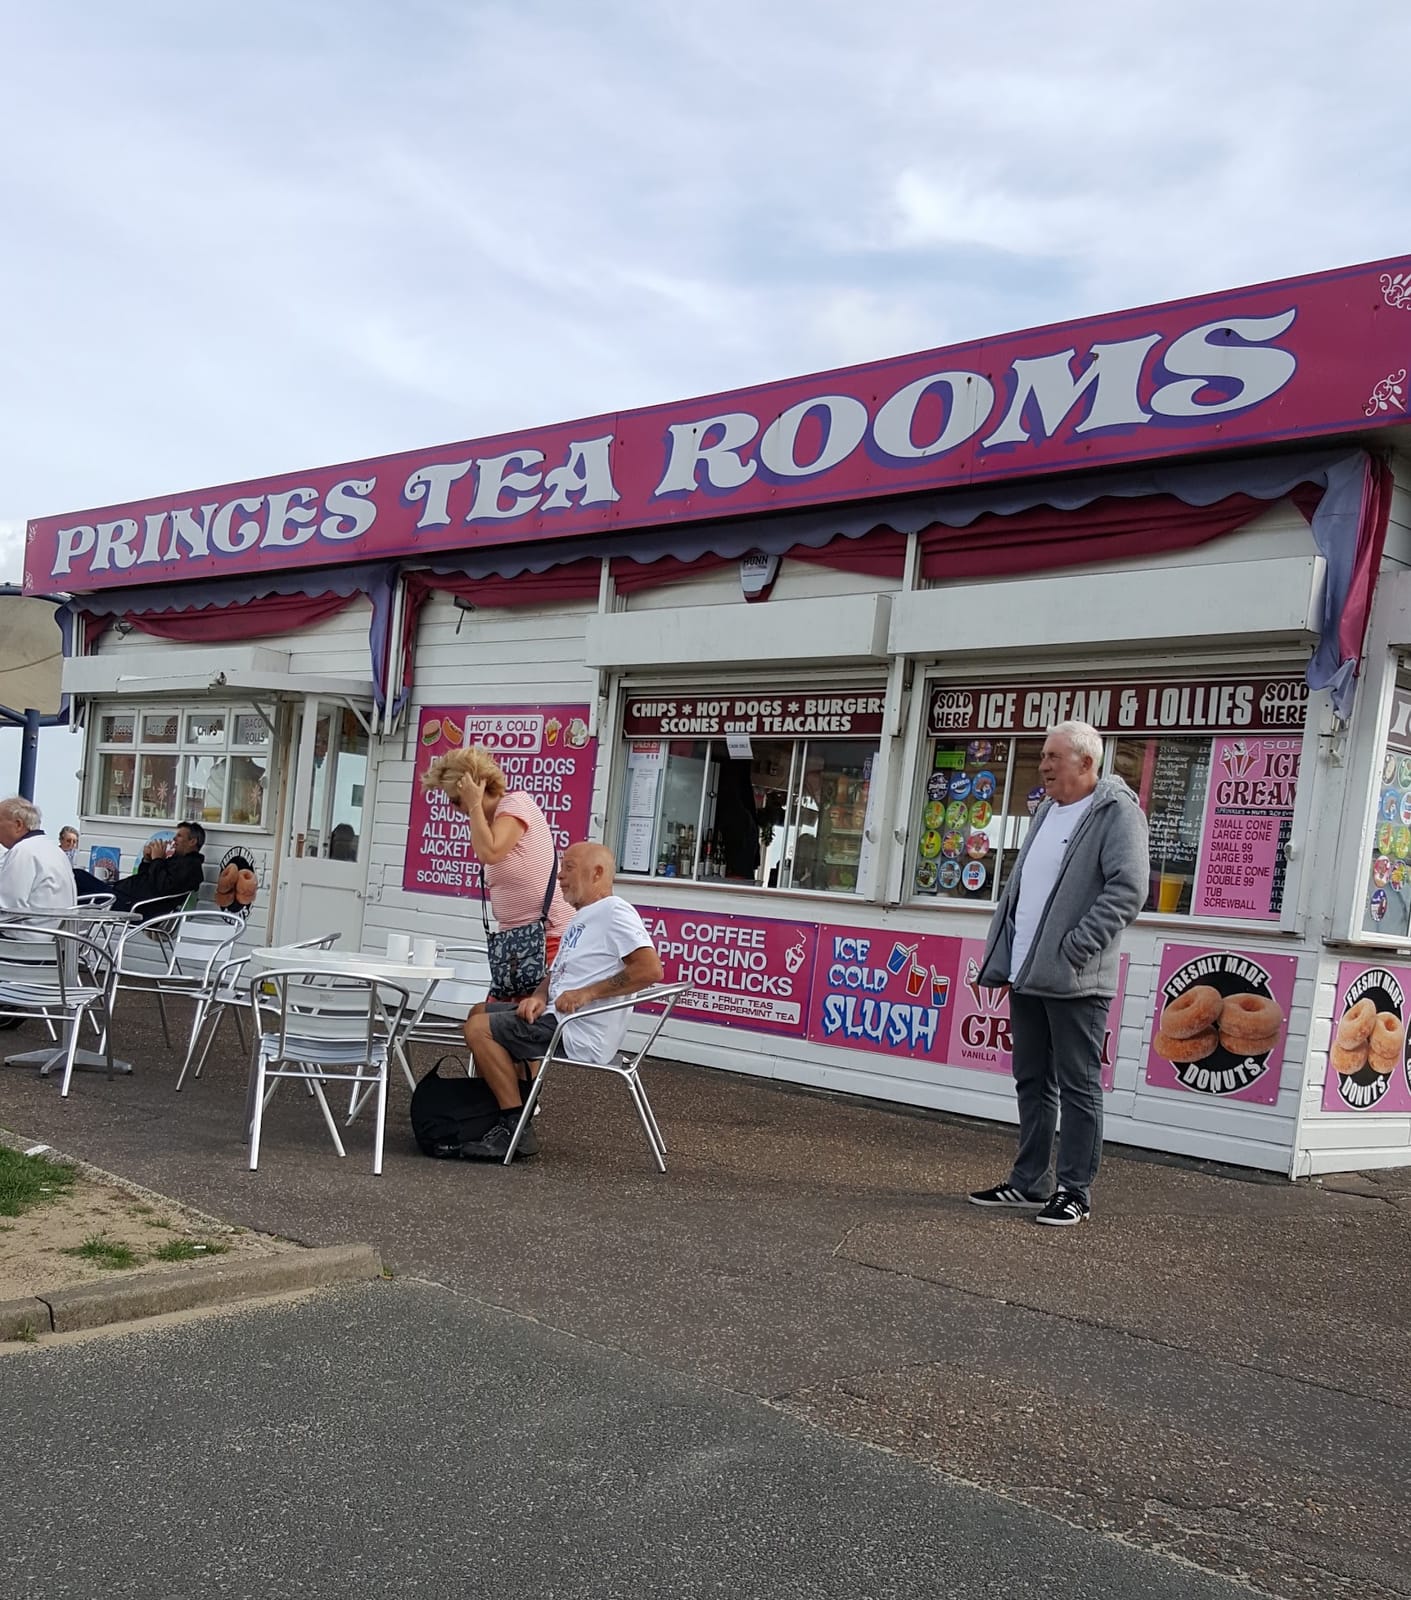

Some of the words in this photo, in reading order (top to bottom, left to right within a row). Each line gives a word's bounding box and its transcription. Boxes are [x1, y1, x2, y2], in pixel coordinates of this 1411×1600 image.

[50, 476, 378, 576] PRINCES
[404, 433, 620, 528] TEA
[653, 308, 1297, 495] ROOMS
[1265, 683, 1309, 701] SOLD
[632, 702, 677, 717] CHIPS
[696, 701, 730, 716] HOT
[734, 700, 783, 715] DOGS
[938, 694, 970, 709] SOLD
[977, 694, 1016, 728] ICE
[1023, 690, 1112, 728] CREAM
[1118, 691, 1138, 726] &
[1145, 686, 1254, 726] LOLLIES
[936, 712, 969, 727] HERE
[1263, 705, 1308, 723] HERE
[198, 725, 218, 736] CHIPS
[471, 720, 493, 731] HOT
[496, 720, 503, 731] &
[507, 720, 538, 731] COLD
[660, 718, 719, 732] SCONES
[724, 717, 757, 732] and
[763, 716, 852, 732] TEACAKES
[245, 732, 265, 742] ROLLS
[470, 732, 536, 748] FOOD
[1263, 740, 1302, 750] SOF
[501, 757, 527, 775] HOT
[532, 758, 576, 776] DOGS
[505, 775, 562, 793] URGERS
[430, 805, 470, 823] SAUS
[422, 822, 446, 839] ALL
[1213, 819, 1243, 829] SMALL
[1246, 820, 1272, 830] CONE
[1212, 829, 1242, 840] LARGE
[1245, 831, 1271, 841] CONE
[420, 839, 470, 859] JACKET
[1210, 841, 1239, 852] SMALL
[1242, 842, 1253, 852] 99
[1209, 852, 1240, 863] LARGE
[1242, 854, 1254, 863] 99
[431, 859, 481, 876] TOASTED
[1207, 864, 1243, 876] DOUBLE
[1244, 866, 1270, 877] CONE
[417, 870, 462, 887] SCONES
[465, 877, 474, 888] &
[1206, 875, 1242, 886] DOUBLE
[1243, 876, 1254, 887] 99
[1205, 886, 1222, 896] TUB
[1203, 897, 1257, 910] SCREWBALL
[641, 917, 668, 938] EA
[680, 922, 767, 949] COFFEE
[657, 941, 768, 971] PPUCCINO
[833, 936, 871, 961] ICE
[678, 963, 794, 998] HORLICKS
[829, 964, 888, 990] COLD
[1167, 955, 1221, 998] FRESHLY
[1225, 956, 1266, 988] MADE
[1347, 971, 1382, 1008] FRESHLY
[1382, 973, 1403, 1009] MADE
[718, 994, 745, 1006] FRUIT
[748, 998, 773, 1010] TEAS
[703, 1001, 712, 1009] &
[713, 1002, 772, 1019] PEPPERMINT
[775, 1012, 795, 1022] TEA
[826, 994, 940, 1052] SLUSH
[962, 1050, 997, 1062] VANILLA
[1184, 1057, 1260, 1093] DONUTS
[1341, 1075, 1386, 1106] DONUTS
